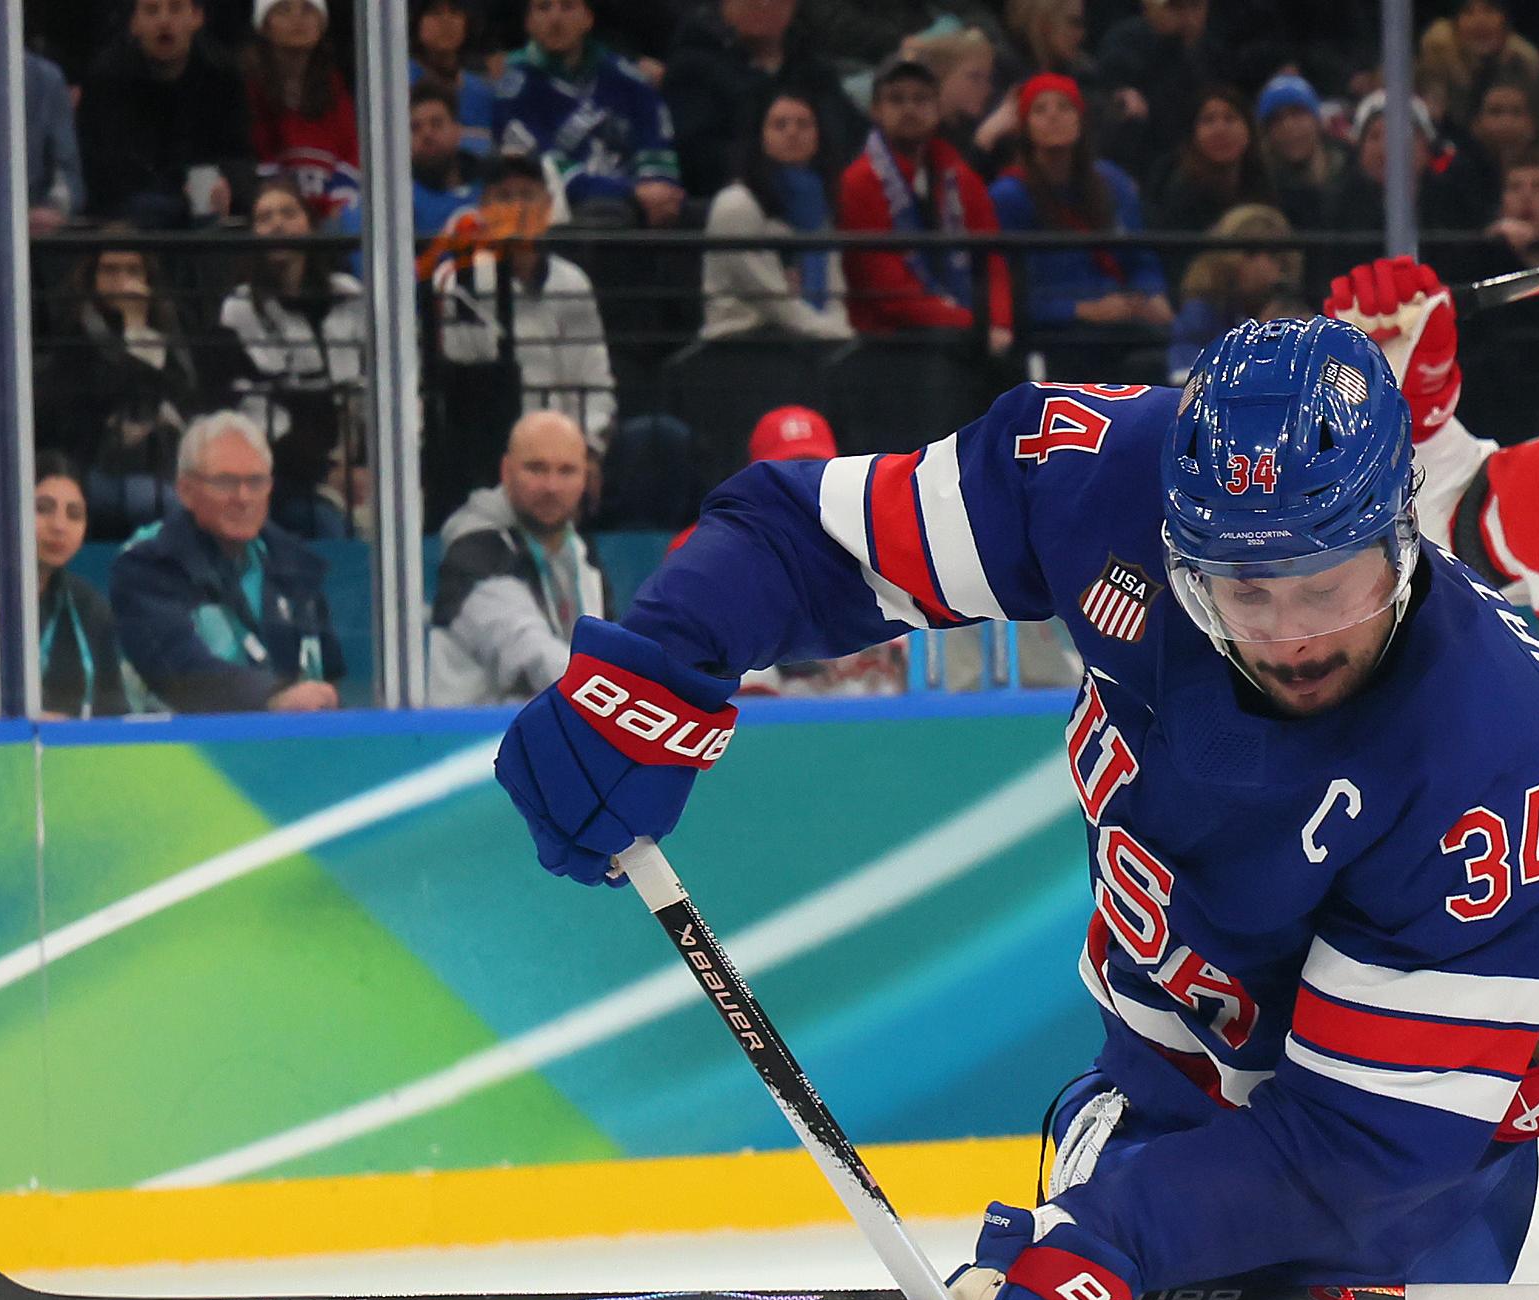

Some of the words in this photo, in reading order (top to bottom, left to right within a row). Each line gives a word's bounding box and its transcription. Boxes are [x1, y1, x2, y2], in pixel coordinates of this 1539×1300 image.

[1323, 362, 1340, 383] USA
[1226, 453, 1276, 495] 34
[1220, 531, 1254, 539] MILANO
[1255, 530, 1292, 539] CORTINA
[1110, 564, 1148, 600] USA
[1301, 778, 1362, 863] C
[1064, 671, 1260, 1050] USA
[688, 949, 765, 1051] BAUER
